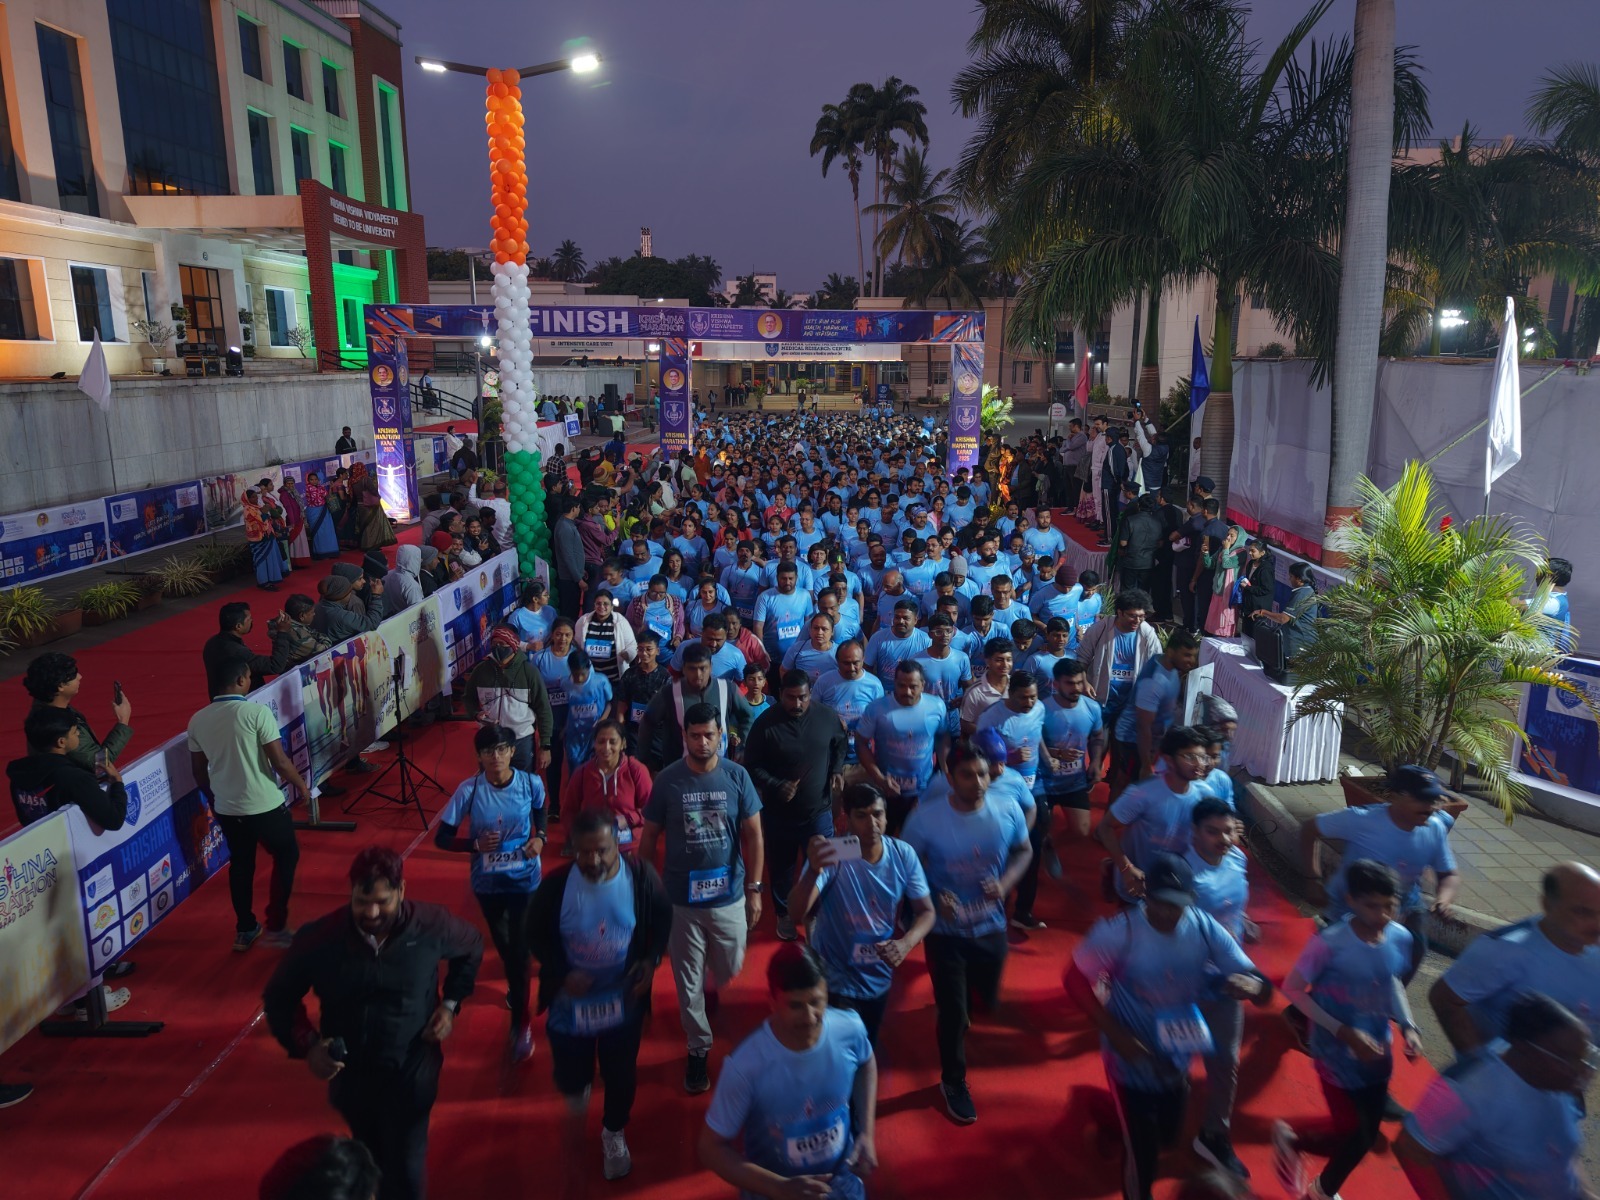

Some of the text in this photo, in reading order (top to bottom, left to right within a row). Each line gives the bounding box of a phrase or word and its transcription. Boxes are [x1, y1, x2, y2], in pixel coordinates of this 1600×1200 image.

[364, 210, 399, 225] VIDYAPEETH
[348, 219, 356, 229] TO
[356, 222, 362, 232] BE
[362, 224, 395, 238] UNIVERSITY
[528, 309, 629, 333] FINISH
[639, 314, 685, 324] KRISHNA
[640, 323, 684, 331] MARATHON
[138, 768, 162, 787] KRISHNA
[140, 777, 162, 795] VISHWA
[18, 793, 47, 806] NASA
[121, 815, 172, 874] KRISHNA
[0, 847, 58, 900] SHNA
[0, 868, 57, 917] RATHON
[697, 877, 725, 890] 5843
